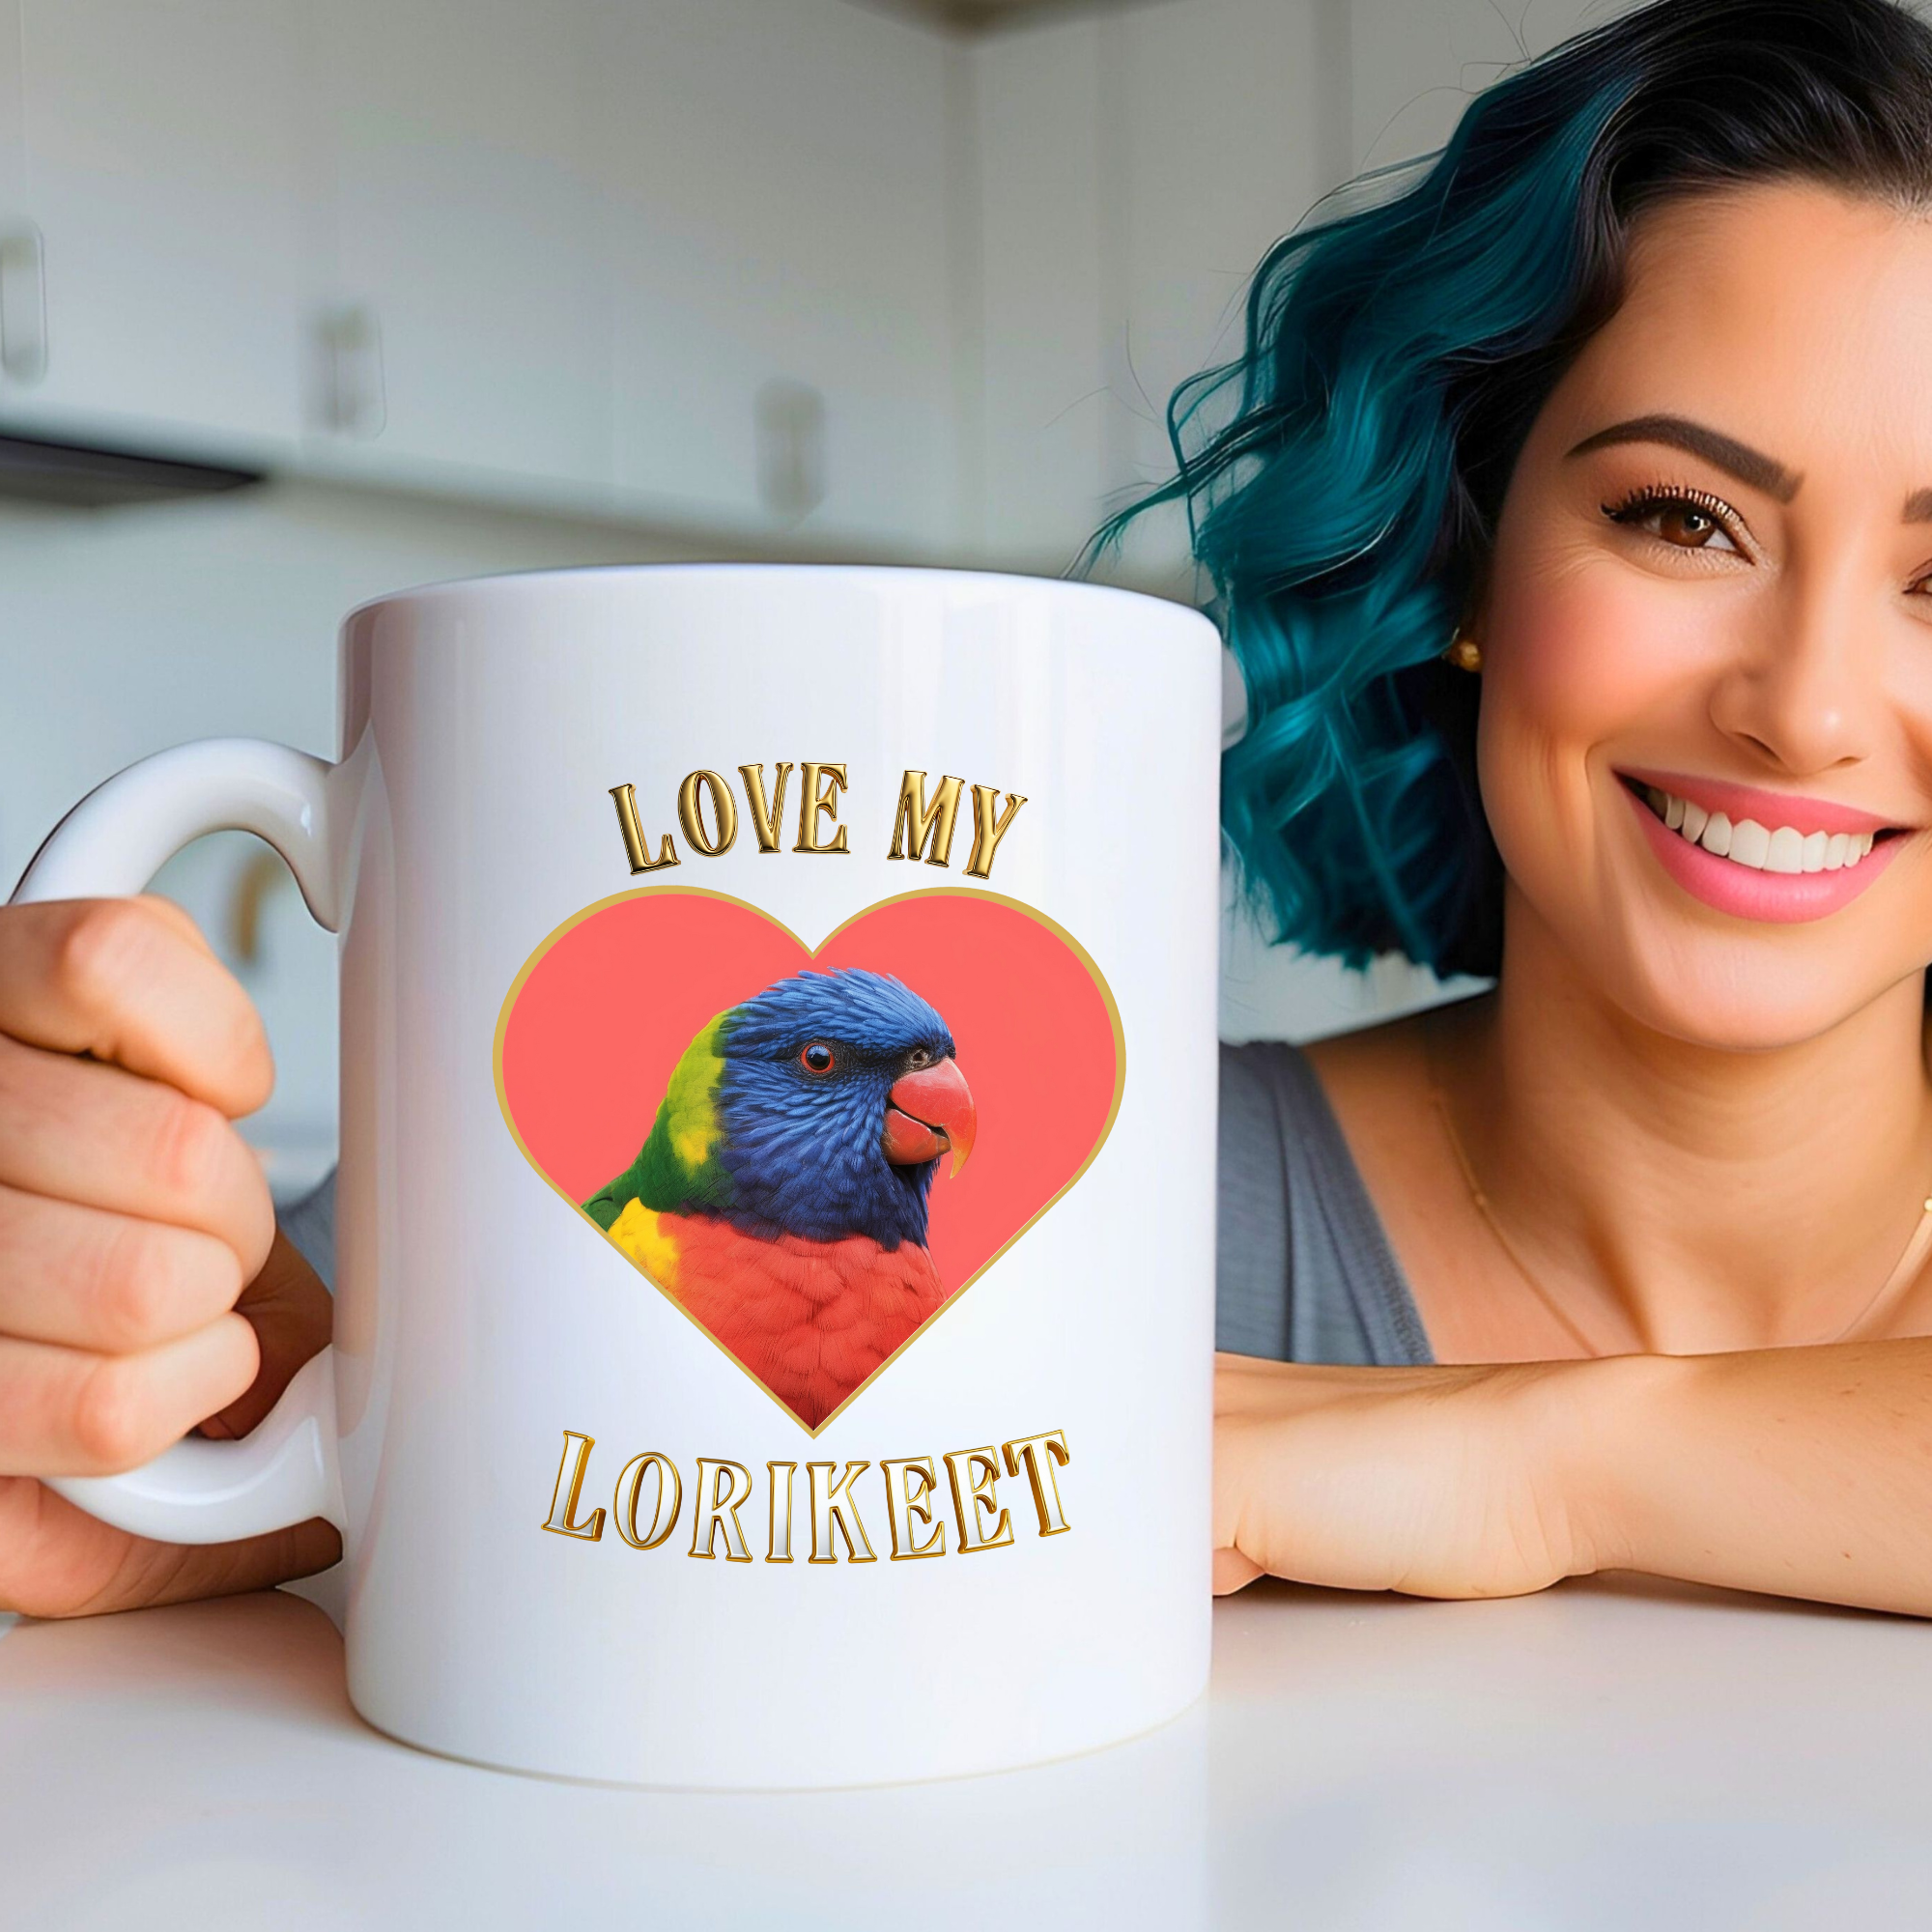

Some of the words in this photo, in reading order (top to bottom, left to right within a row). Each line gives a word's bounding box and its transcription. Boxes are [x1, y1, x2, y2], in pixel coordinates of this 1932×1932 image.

[608, 761, 851, 876] LOVE
[887, 770, 1028, 881] MY
[541, 1429, 1072, 1565] LORIKEET
